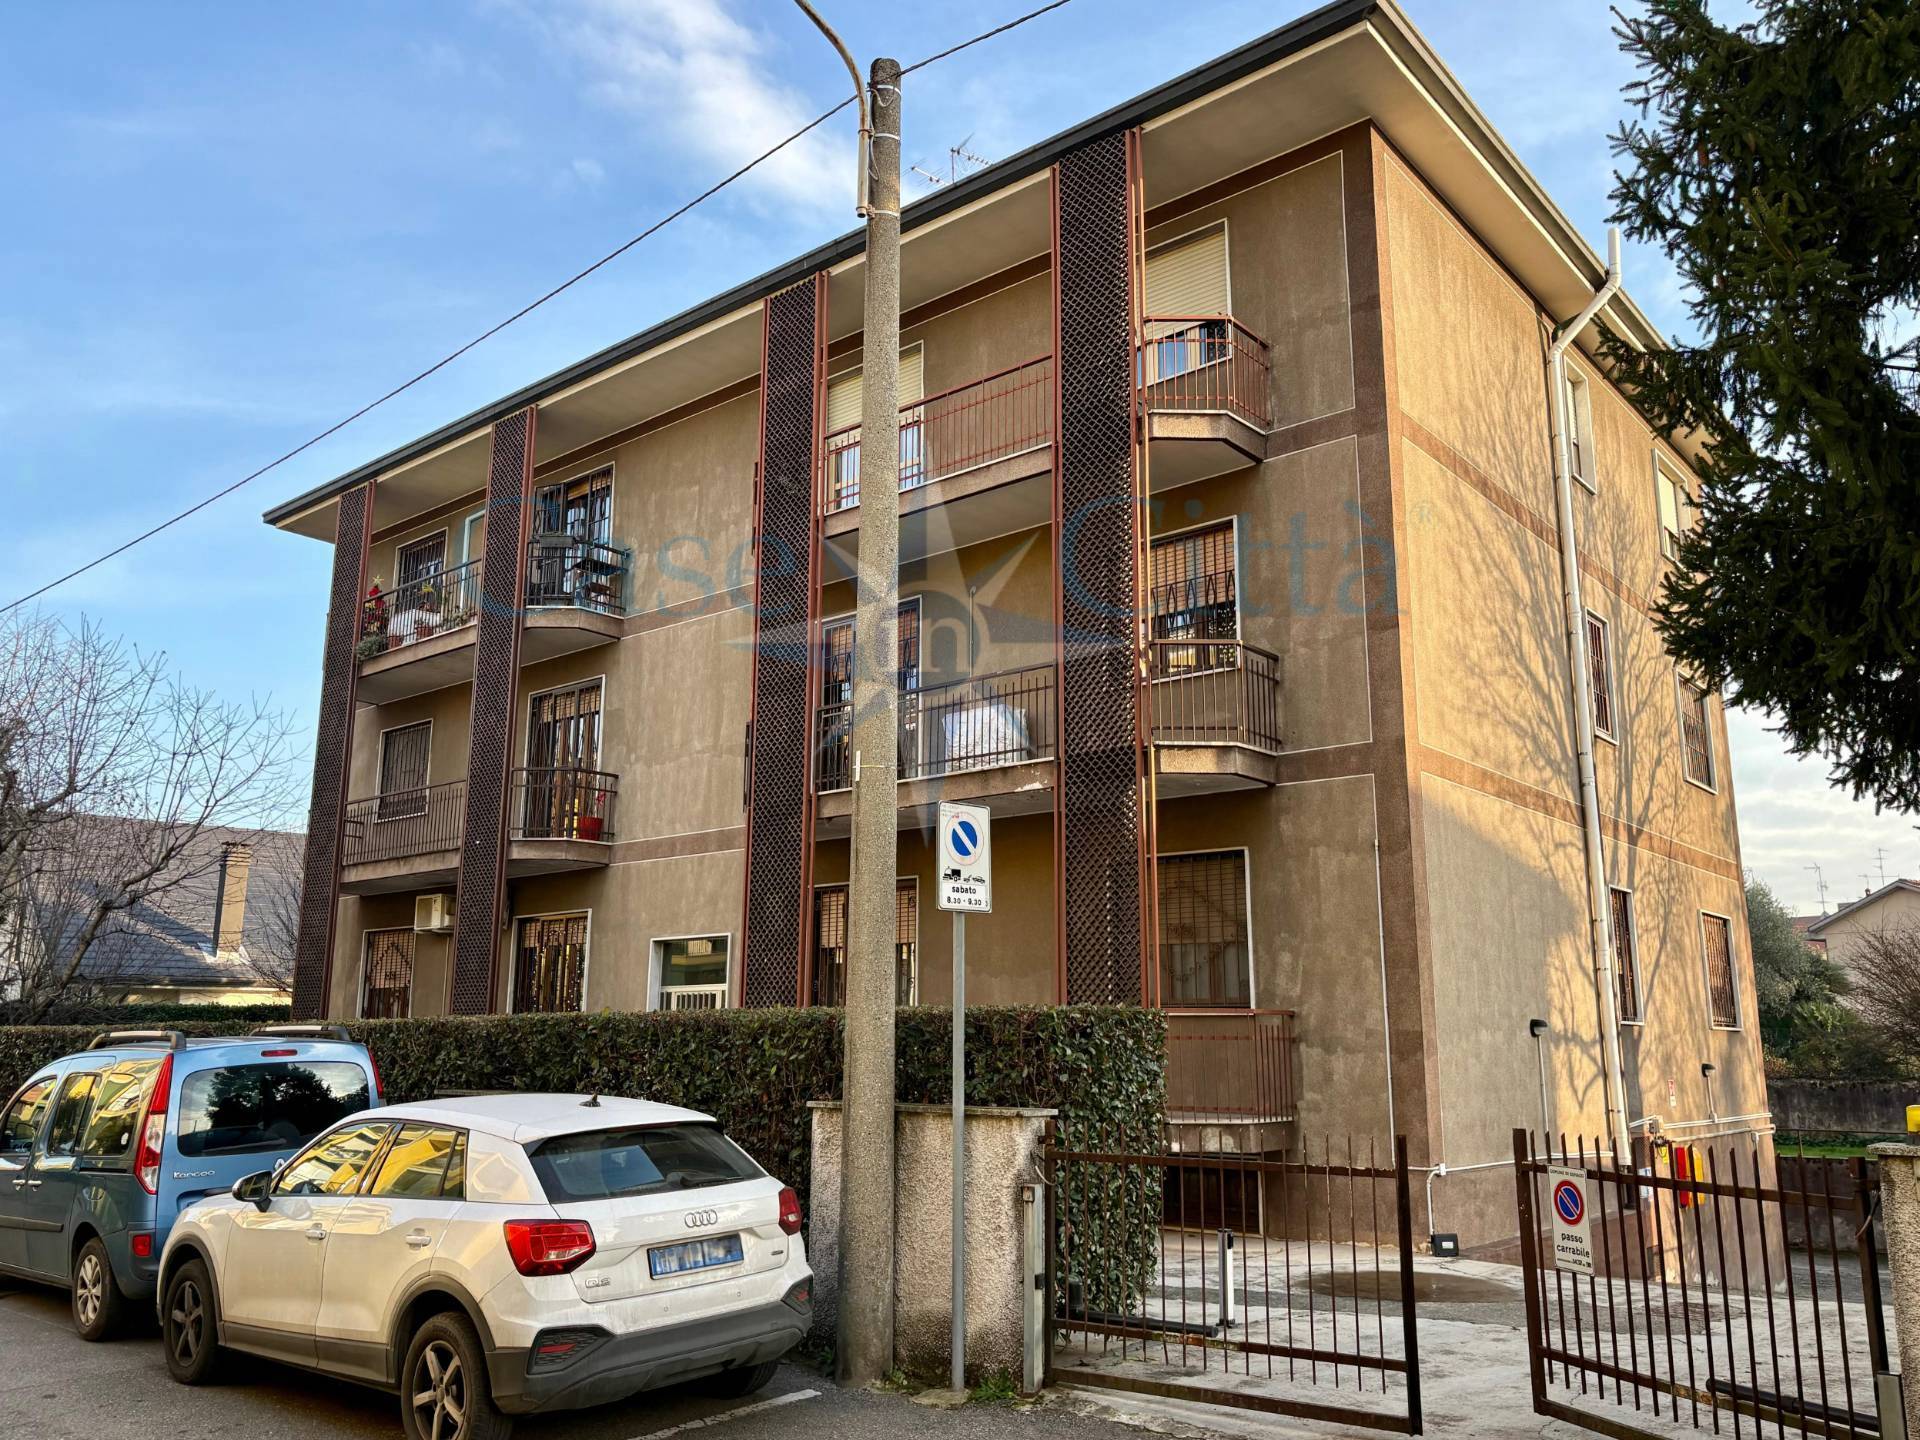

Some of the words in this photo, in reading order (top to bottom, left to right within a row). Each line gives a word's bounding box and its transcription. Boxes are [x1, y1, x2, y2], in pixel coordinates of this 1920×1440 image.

[951, 884, 977, 894] sabato
[946, 895, 961, 904] 8.30
[967, 897, 982, 906] 9.30
[1561, 1232, 1583, 1244] passo
[1556, 1244, 1590, 1258] carrabile
